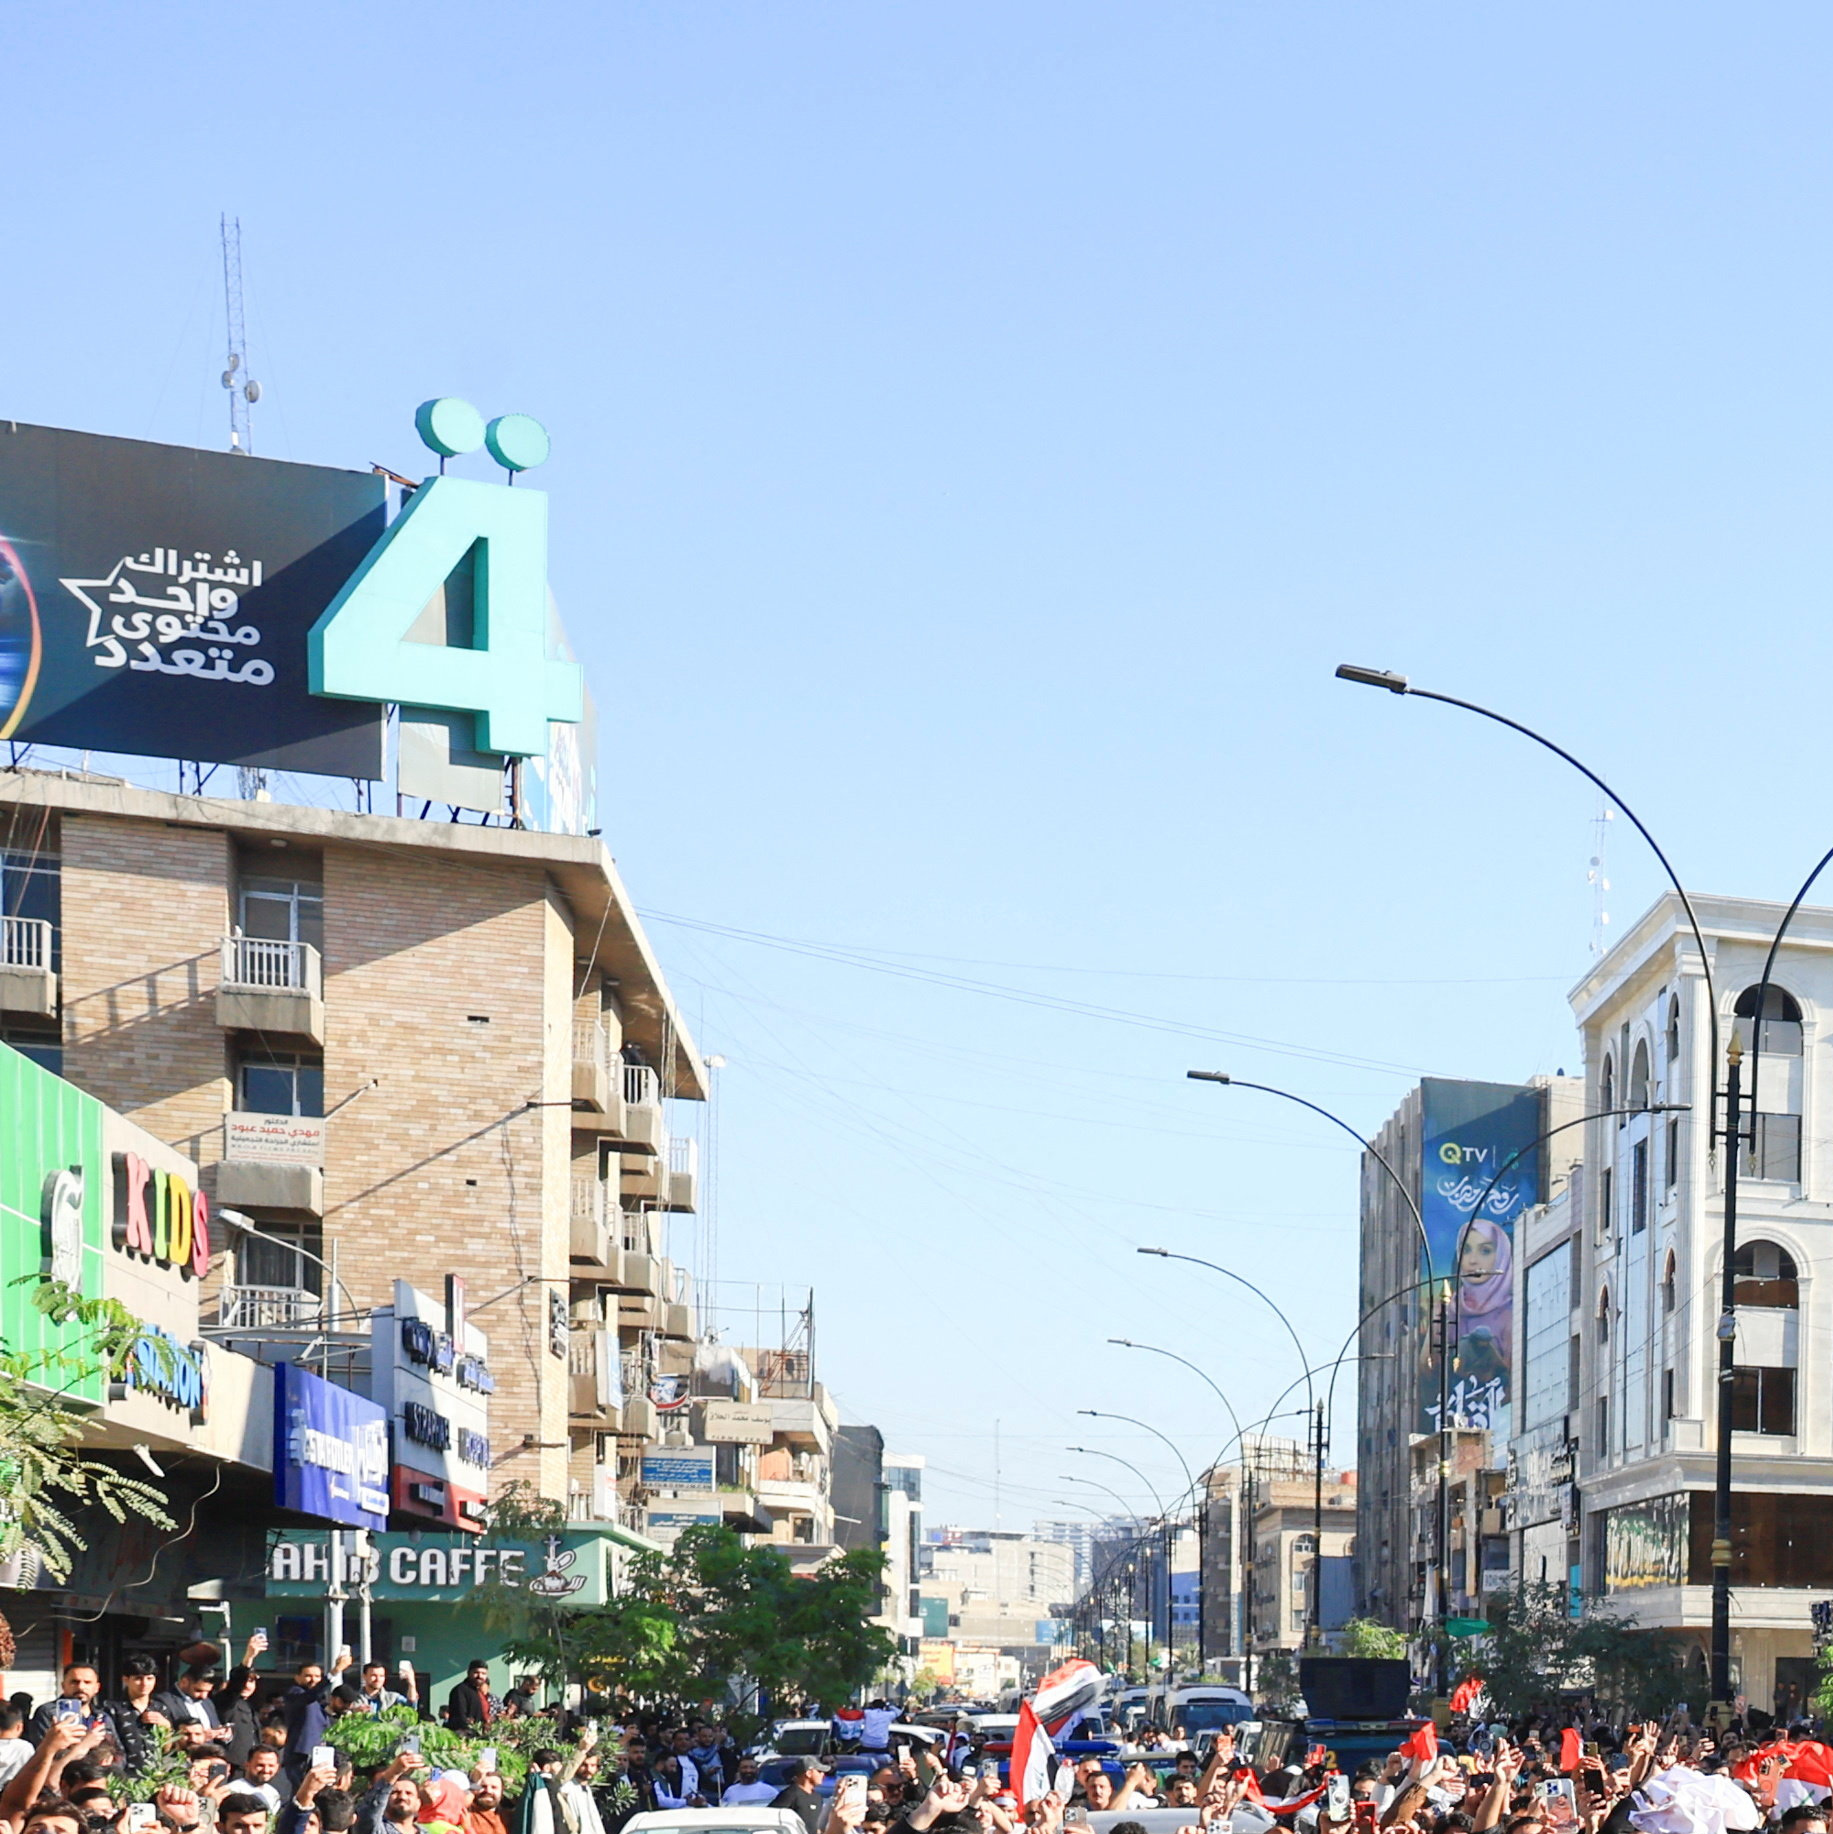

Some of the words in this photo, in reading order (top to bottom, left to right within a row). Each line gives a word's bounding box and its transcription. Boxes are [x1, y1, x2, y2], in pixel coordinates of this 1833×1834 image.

[124, 547, 263, 587] اشتراك
[111, 611, 262, 646] محتوى
[94, 638, 276, 687] متعدد
[124, 1151, 211, 1279] KIDS
[388, 1546, 526, 1588] CAFFE
